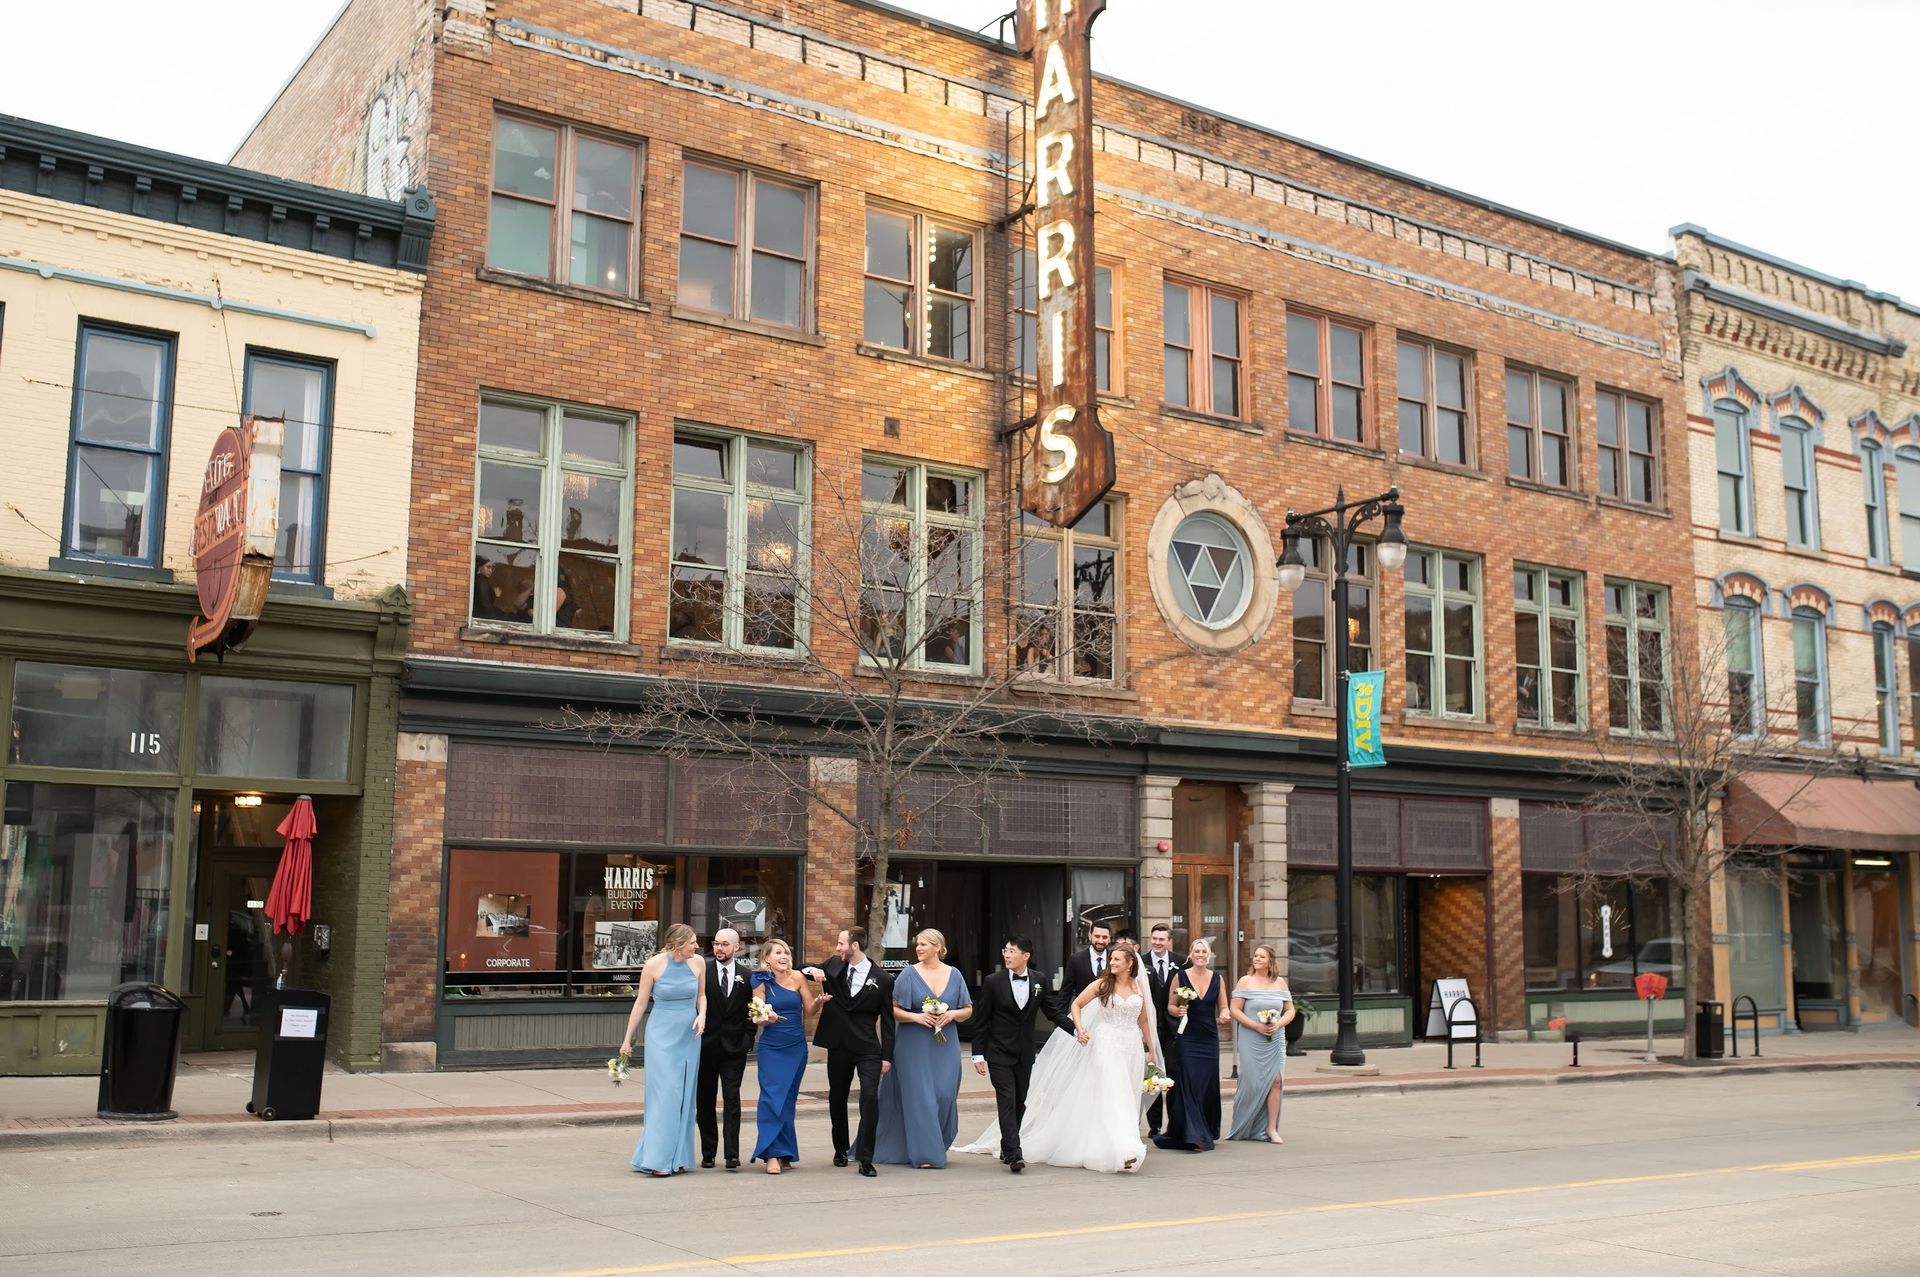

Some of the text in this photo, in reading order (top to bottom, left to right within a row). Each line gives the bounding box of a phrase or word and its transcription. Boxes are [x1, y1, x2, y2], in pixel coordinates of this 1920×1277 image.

[130, 732, 160, 754] 115
[604, 867, 654, 890] HARRIS
[607, 889, 648, 899] BUILDING
[610, 900, 644, 910] EVENTS
[1204, 915, 1225, 924] HARRIS
[486, 958, 530, 968] CORPORATE
[612, 974, 631, 982] HARRIS
